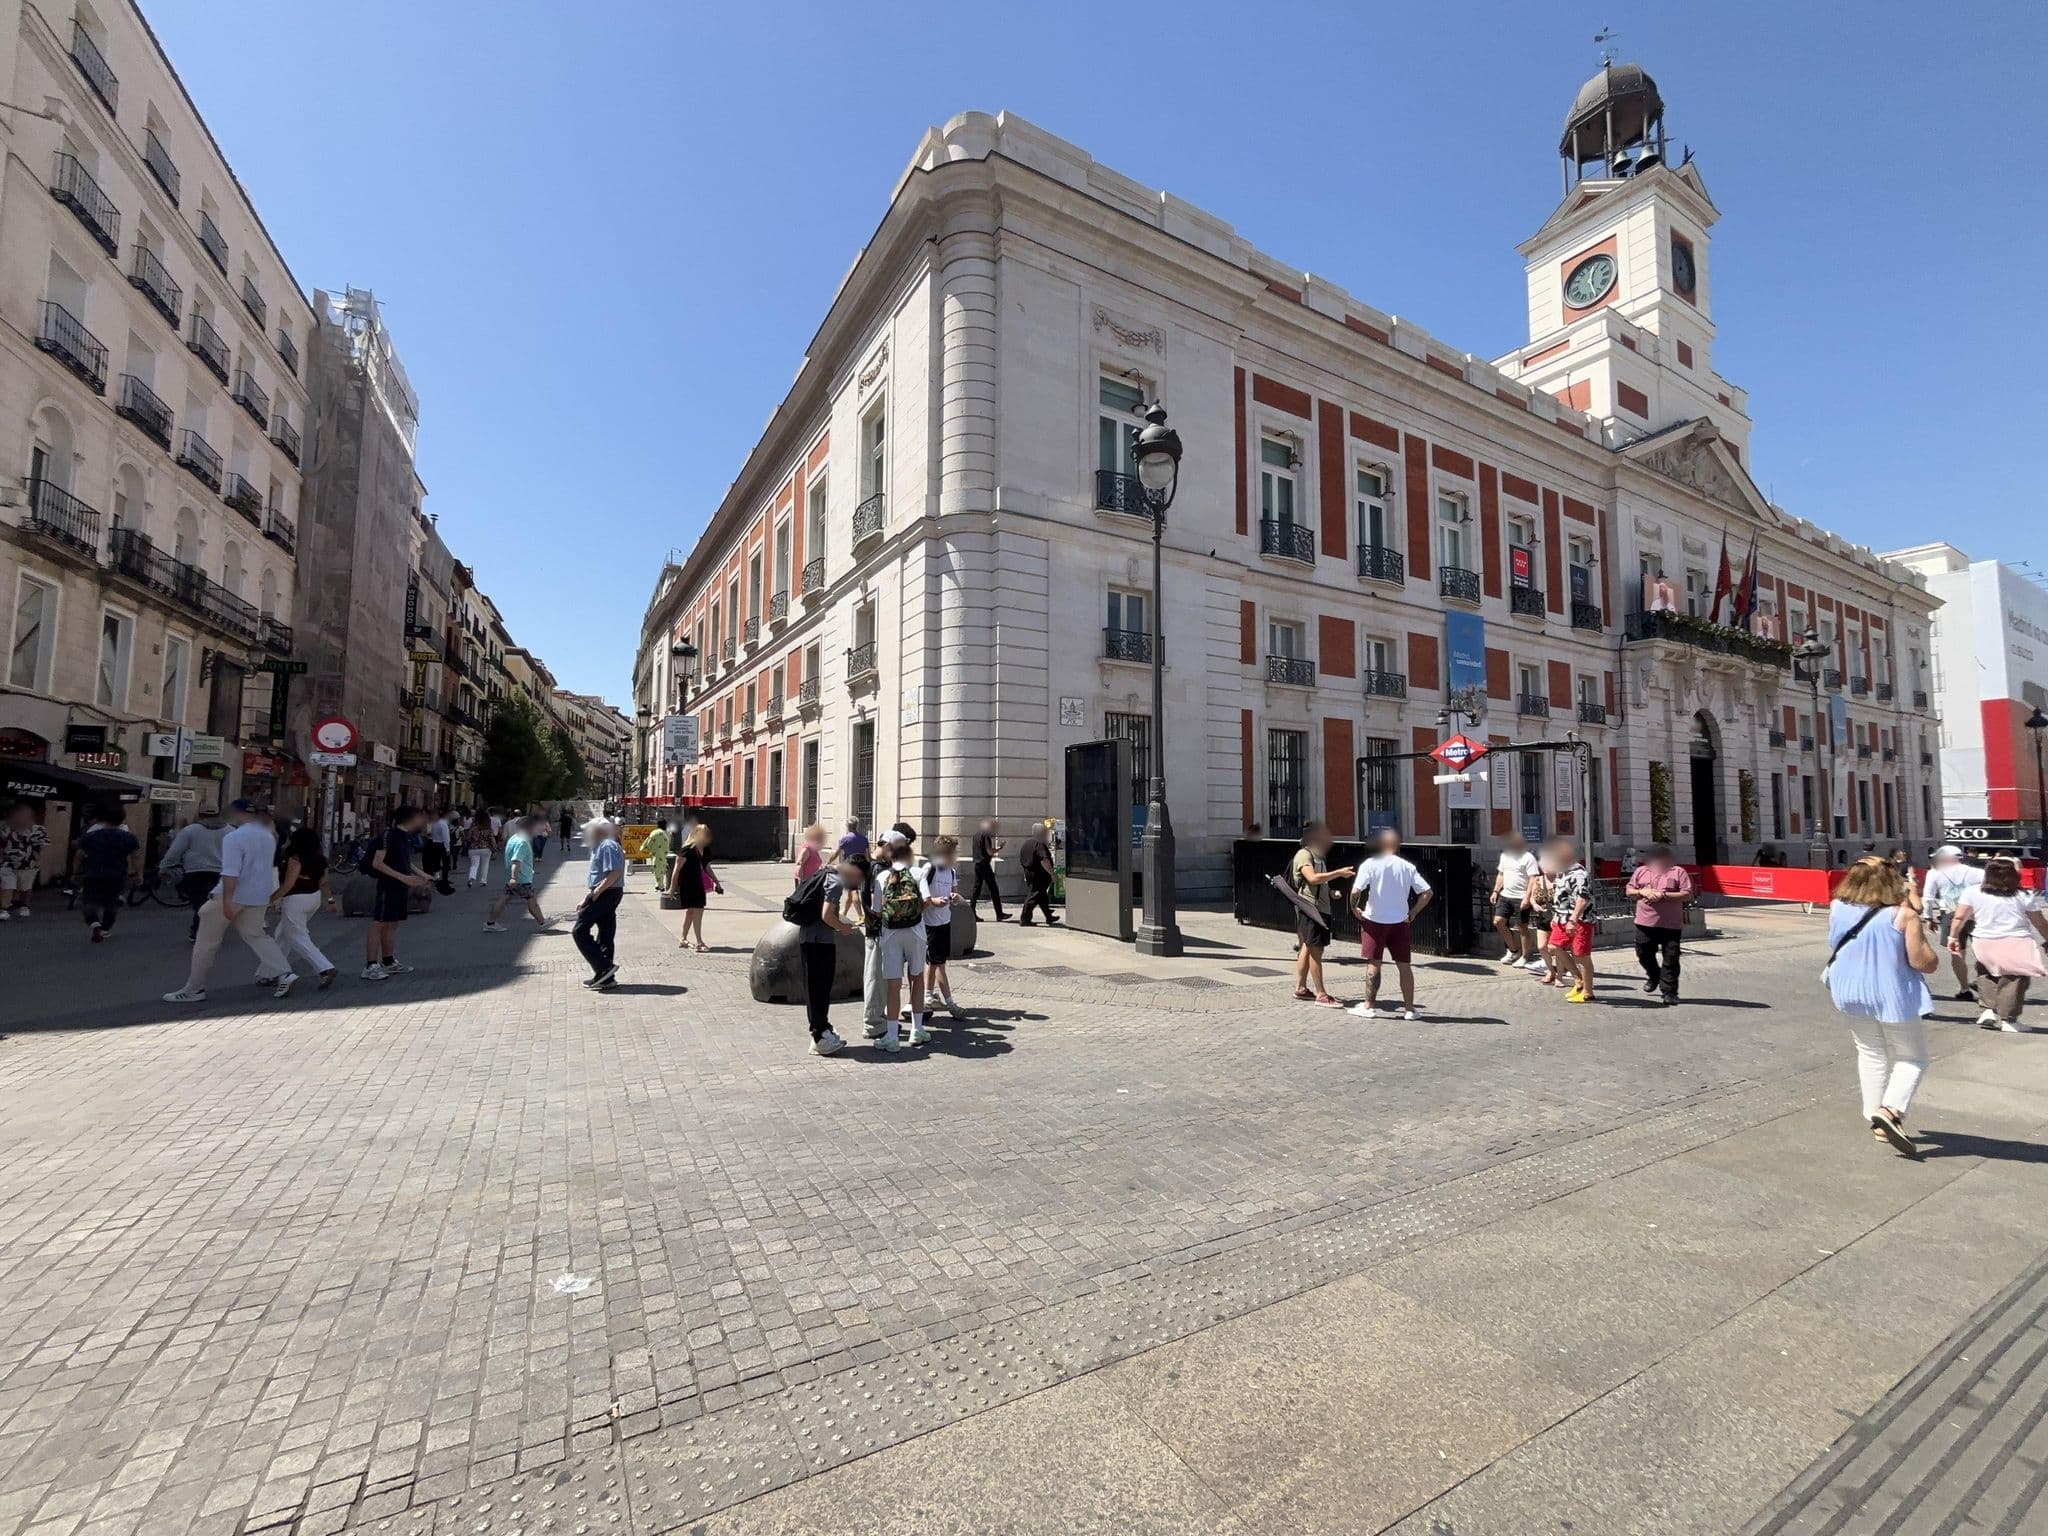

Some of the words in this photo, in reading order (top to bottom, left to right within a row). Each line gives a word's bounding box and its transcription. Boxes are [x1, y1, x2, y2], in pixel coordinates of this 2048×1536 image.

[413, 663, 425, 751] VICTORIA
[78, 752, 120, 766] GELATO
[1445, 748, 1469, 757] Metro
[7, 781, 57, 794] PAPIZZA
